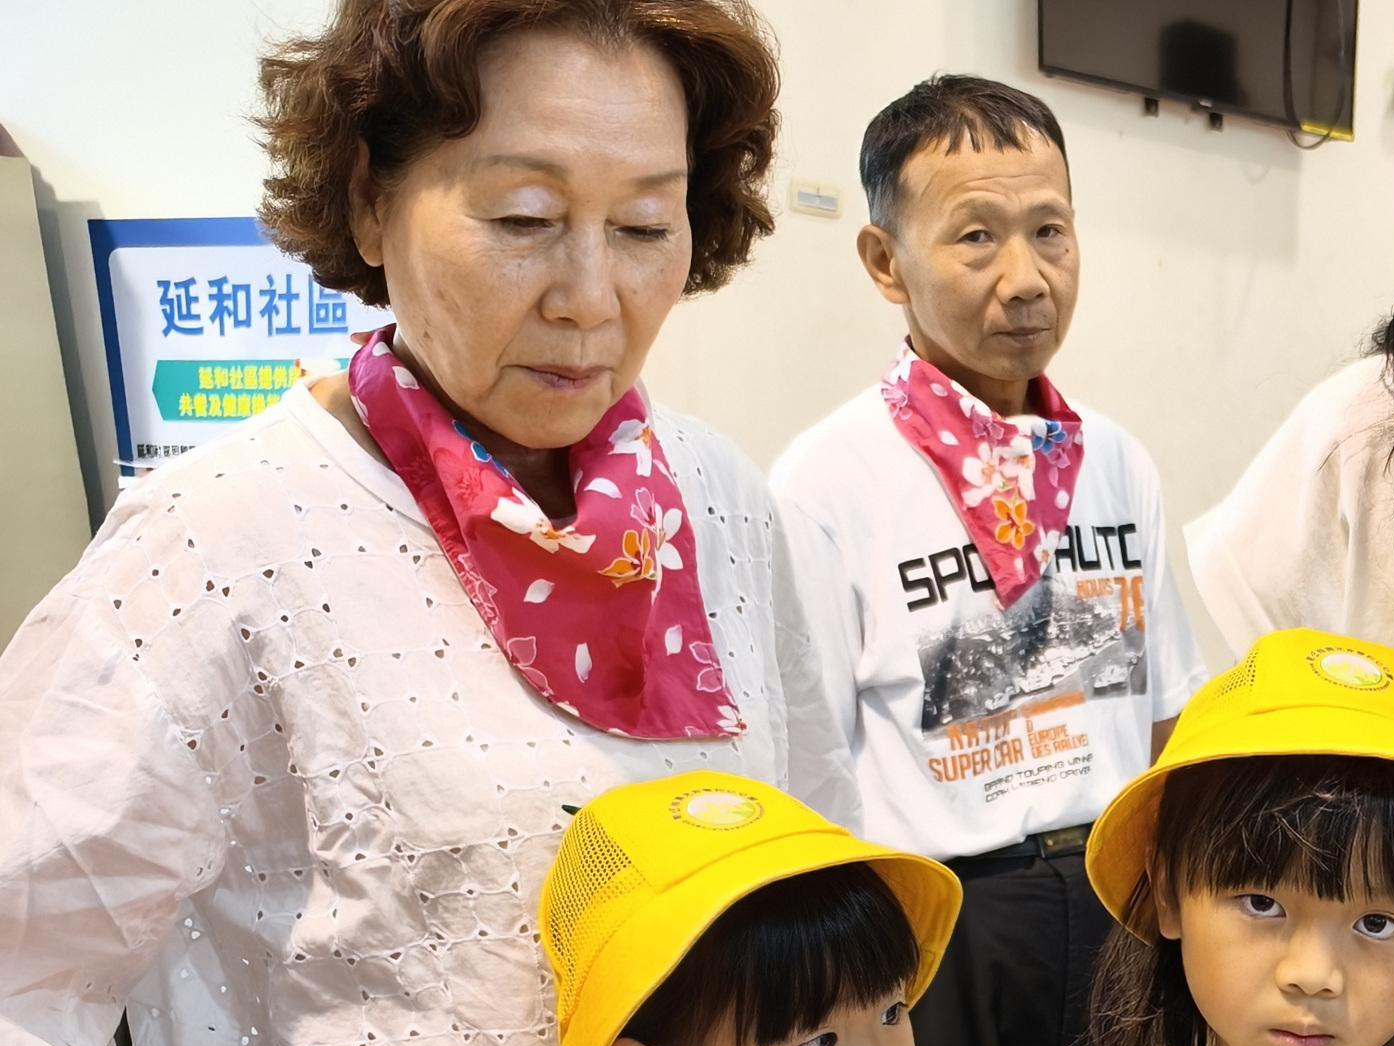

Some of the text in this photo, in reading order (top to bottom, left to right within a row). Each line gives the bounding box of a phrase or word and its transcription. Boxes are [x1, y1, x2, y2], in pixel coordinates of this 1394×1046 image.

[156, 273, 348, 338] 延和社區
[928, 738, 1024, 784] SUPER CAR
